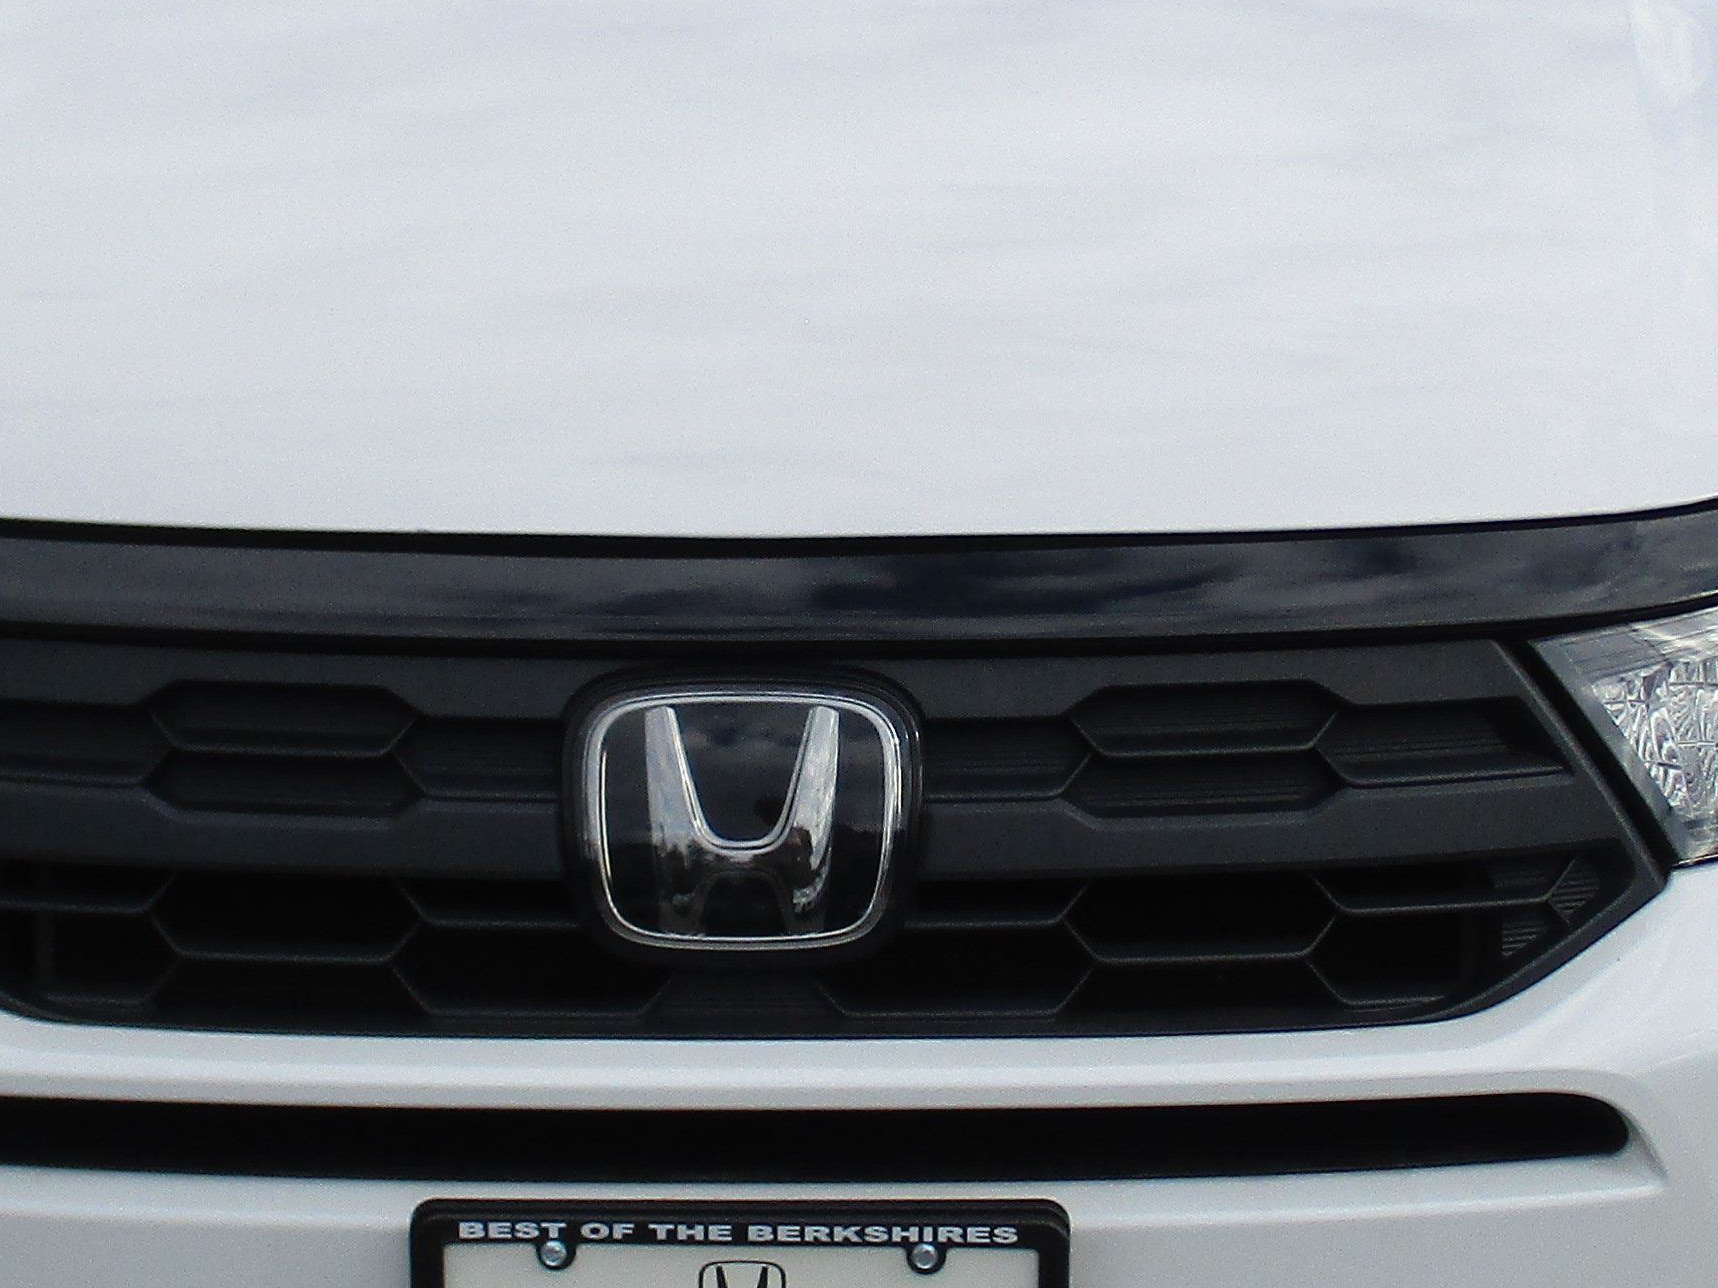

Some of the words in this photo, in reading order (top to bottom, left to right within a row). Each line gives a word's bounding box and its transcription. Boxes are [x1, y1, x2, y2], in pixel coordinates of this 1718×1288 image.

[458, 1221, 567, 1240] BEST
[580, 1222, 635, 1241] OF
[648, 1223, 733, 1242] THE
[746, 1224, 1019, 1244] BERKSHIRES
